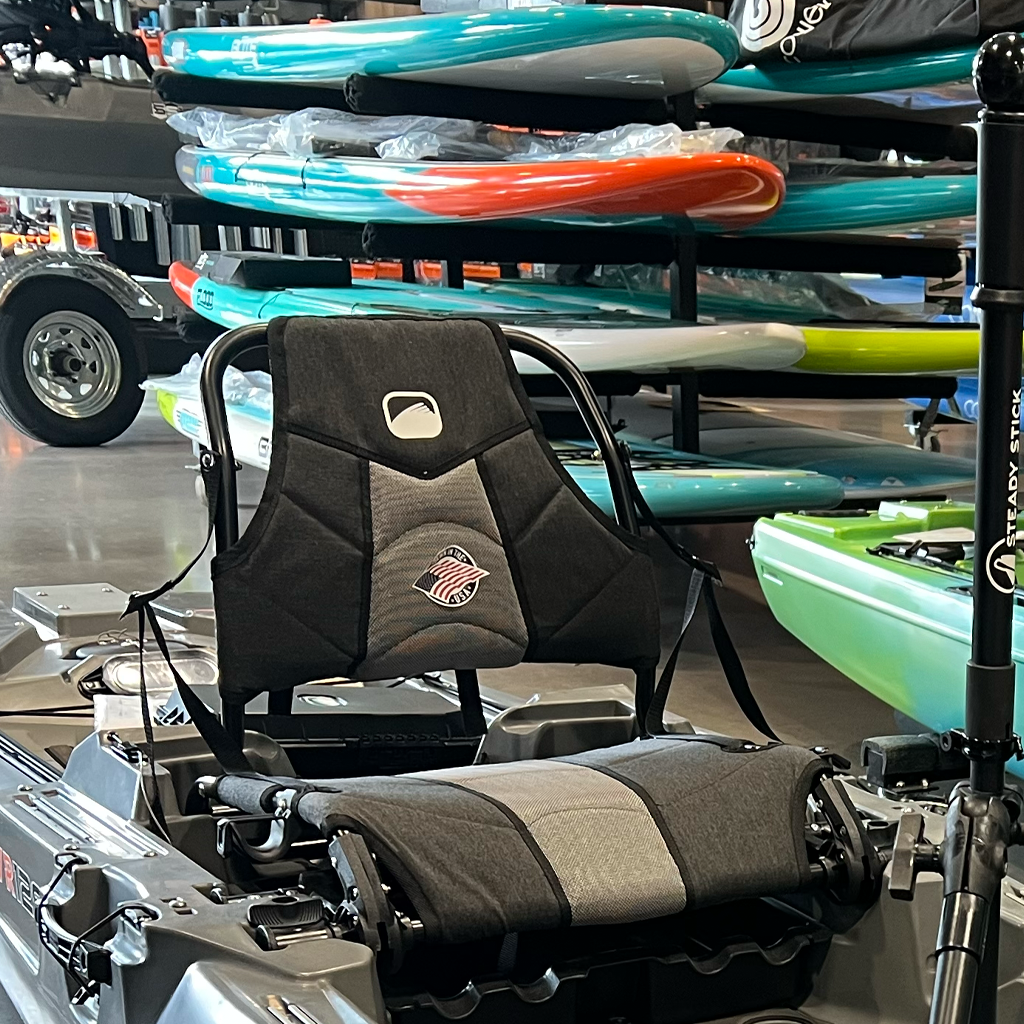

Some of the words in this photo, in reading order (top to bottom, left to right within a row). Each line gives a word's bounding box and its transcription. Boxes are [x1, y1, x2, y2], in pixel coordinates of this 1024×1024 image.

[1010, 389, 1022, 453] STICK
[1006, 461, 1019, 547] STEADY
[453, 588, 471, 603] USA
